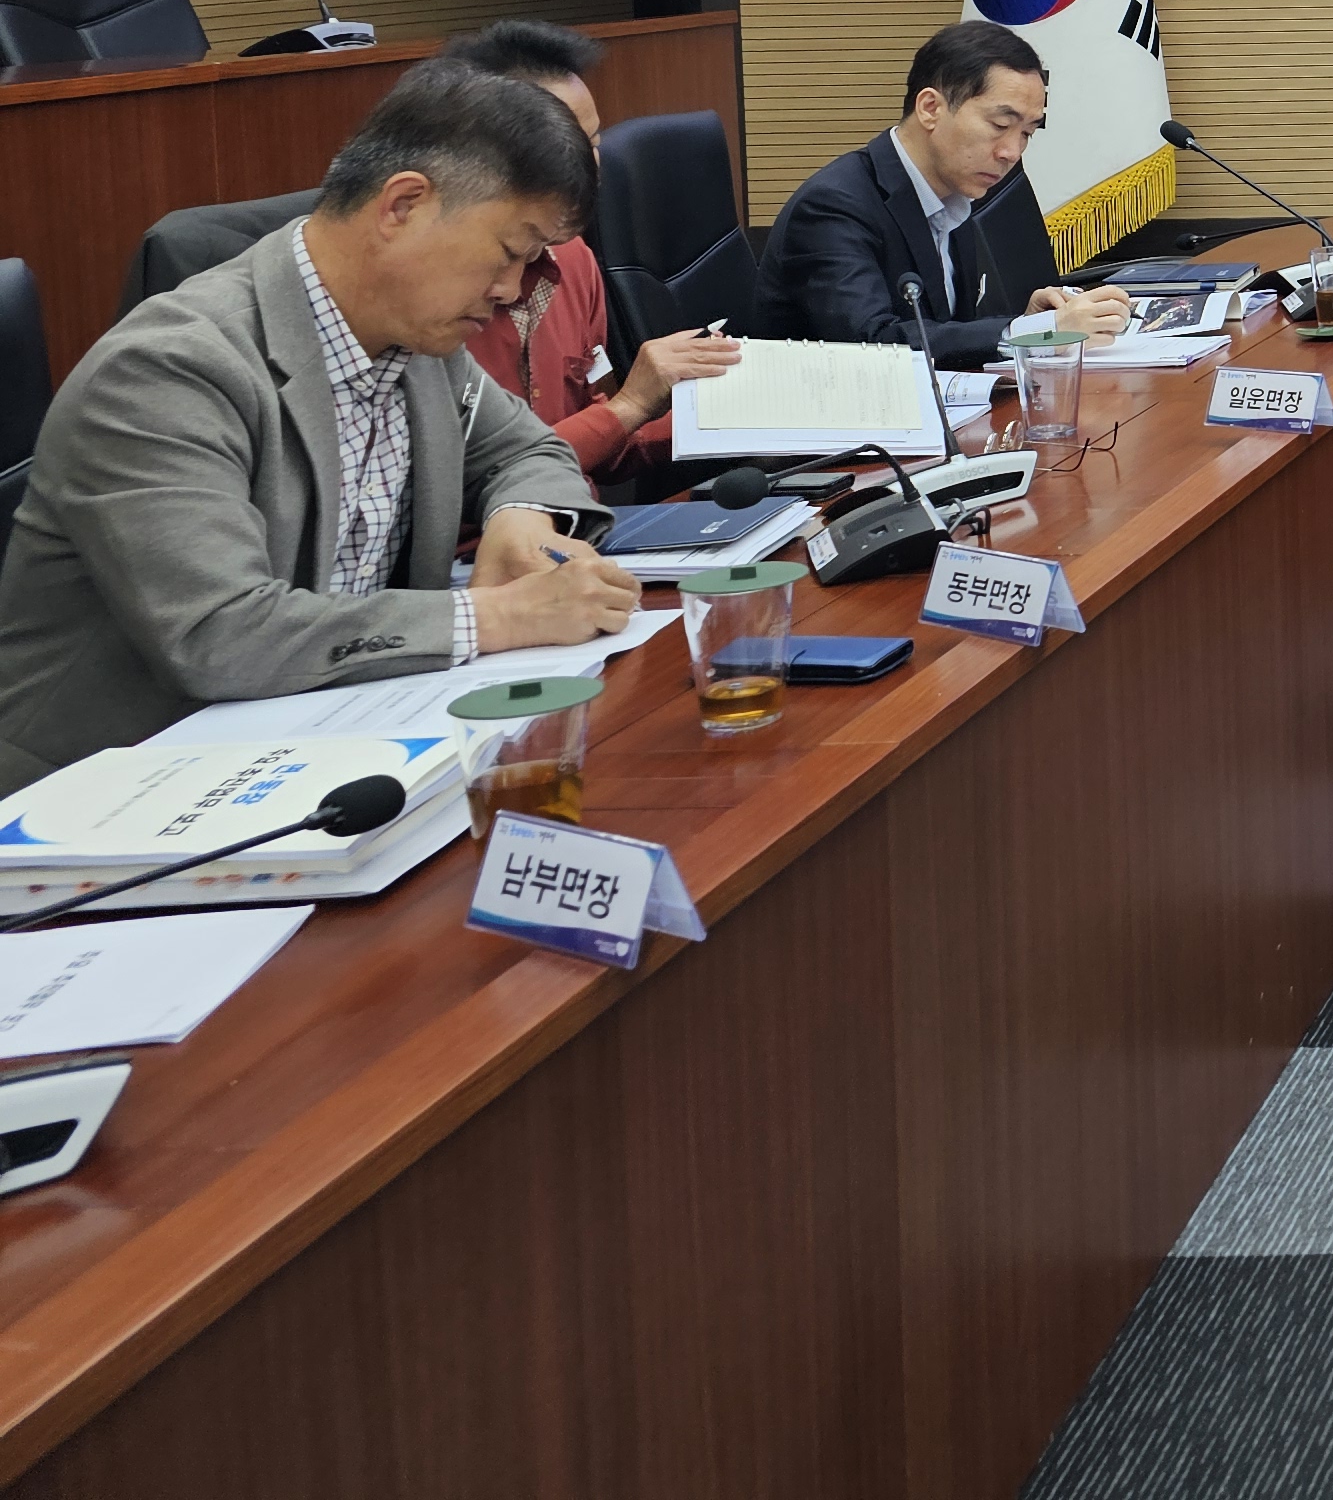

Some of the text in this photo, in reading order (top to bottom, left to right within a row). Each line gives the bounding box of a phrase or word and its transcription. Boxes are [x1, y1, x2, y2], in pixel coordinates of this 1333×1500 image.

[1229, 386, 1303, 414] 일운면장
[959, 464, 989, 479] BOSCH
[947, 571, 1032, 615] 동부면장
[501, 851, 620, 920] 남부면장
